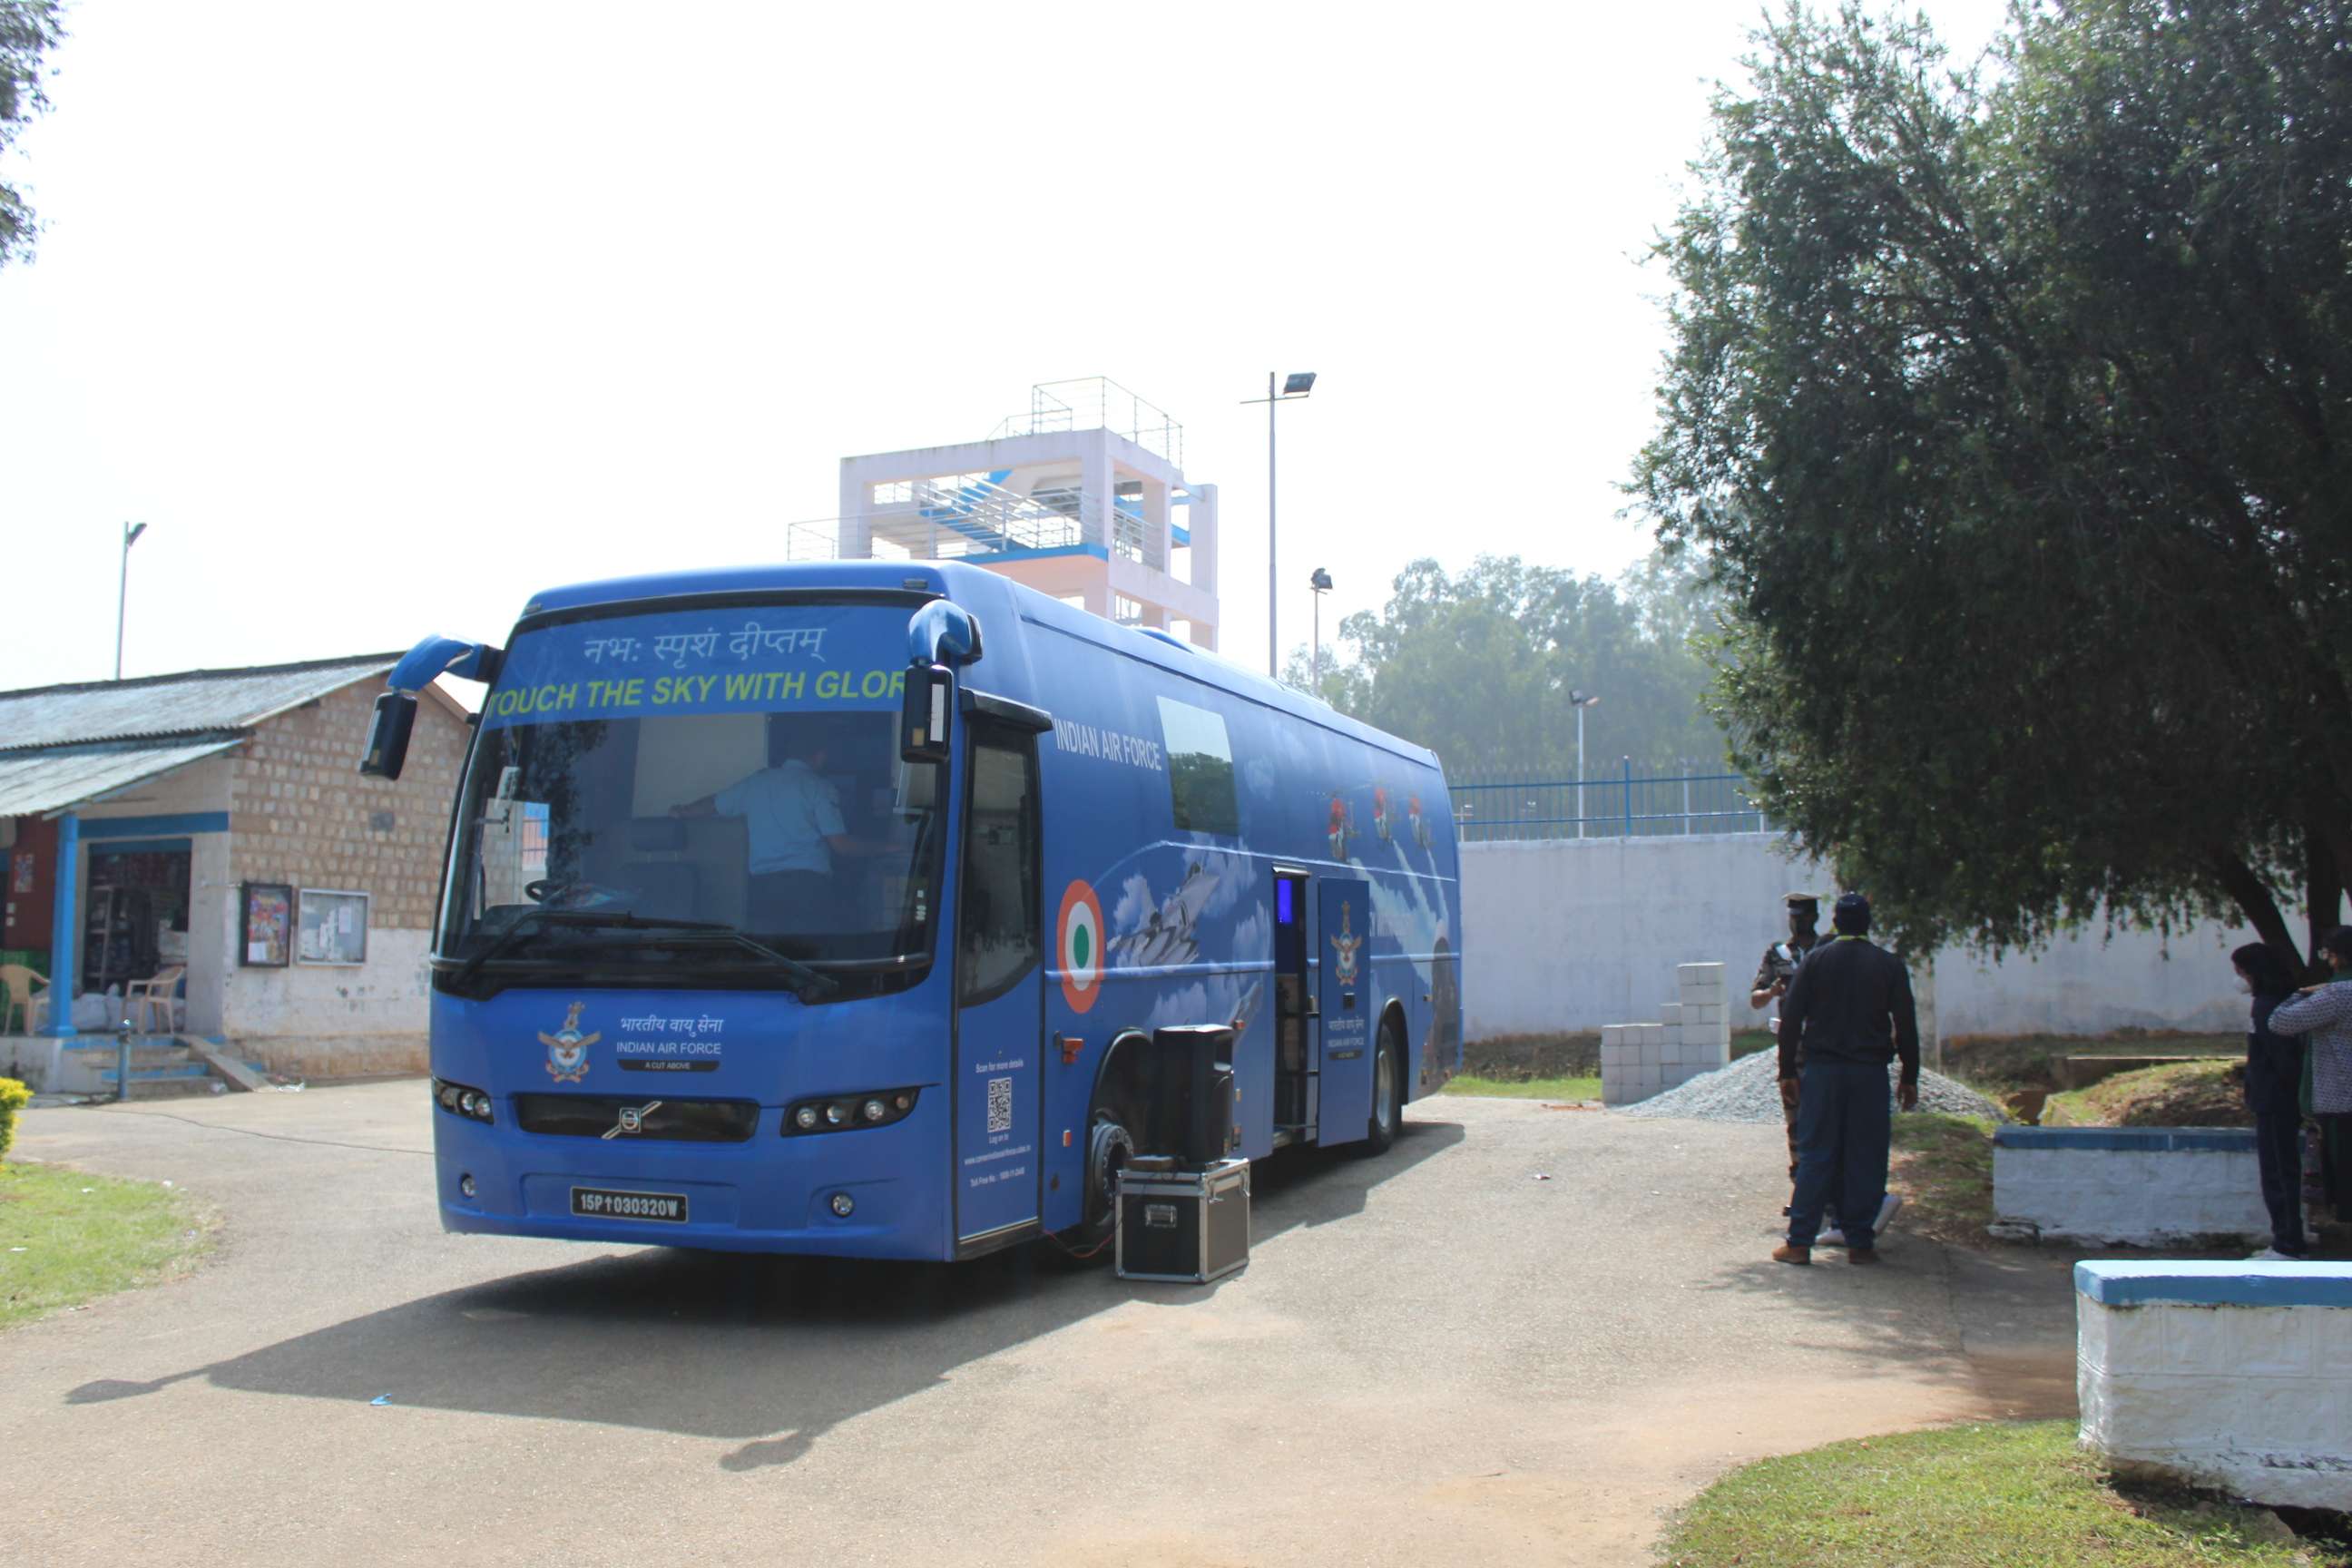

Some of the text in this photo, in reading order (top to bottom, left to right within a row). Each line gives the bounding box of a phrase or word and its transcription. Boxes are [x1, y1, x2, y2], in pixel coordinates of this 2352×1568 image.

[653, 626, 722, 670] स्पृशं
[728, 621, 828, 663] दीप्तम्
[486, 682, 579, 720] TOUCH
[587, 679, 646, 710] THE
[651, 673, 720, 705] SKY
[724, 671, 808, 701] WITH
[1054, 718, 1162, 771] INDIAN AIR FORCE
[621, 1014, 725, 1037] भारतीय वायु सेना
[616, 1042, 722, 1054] INDIAN AIR FORCE
[666, 1062, 691, 1070] ABOVE
